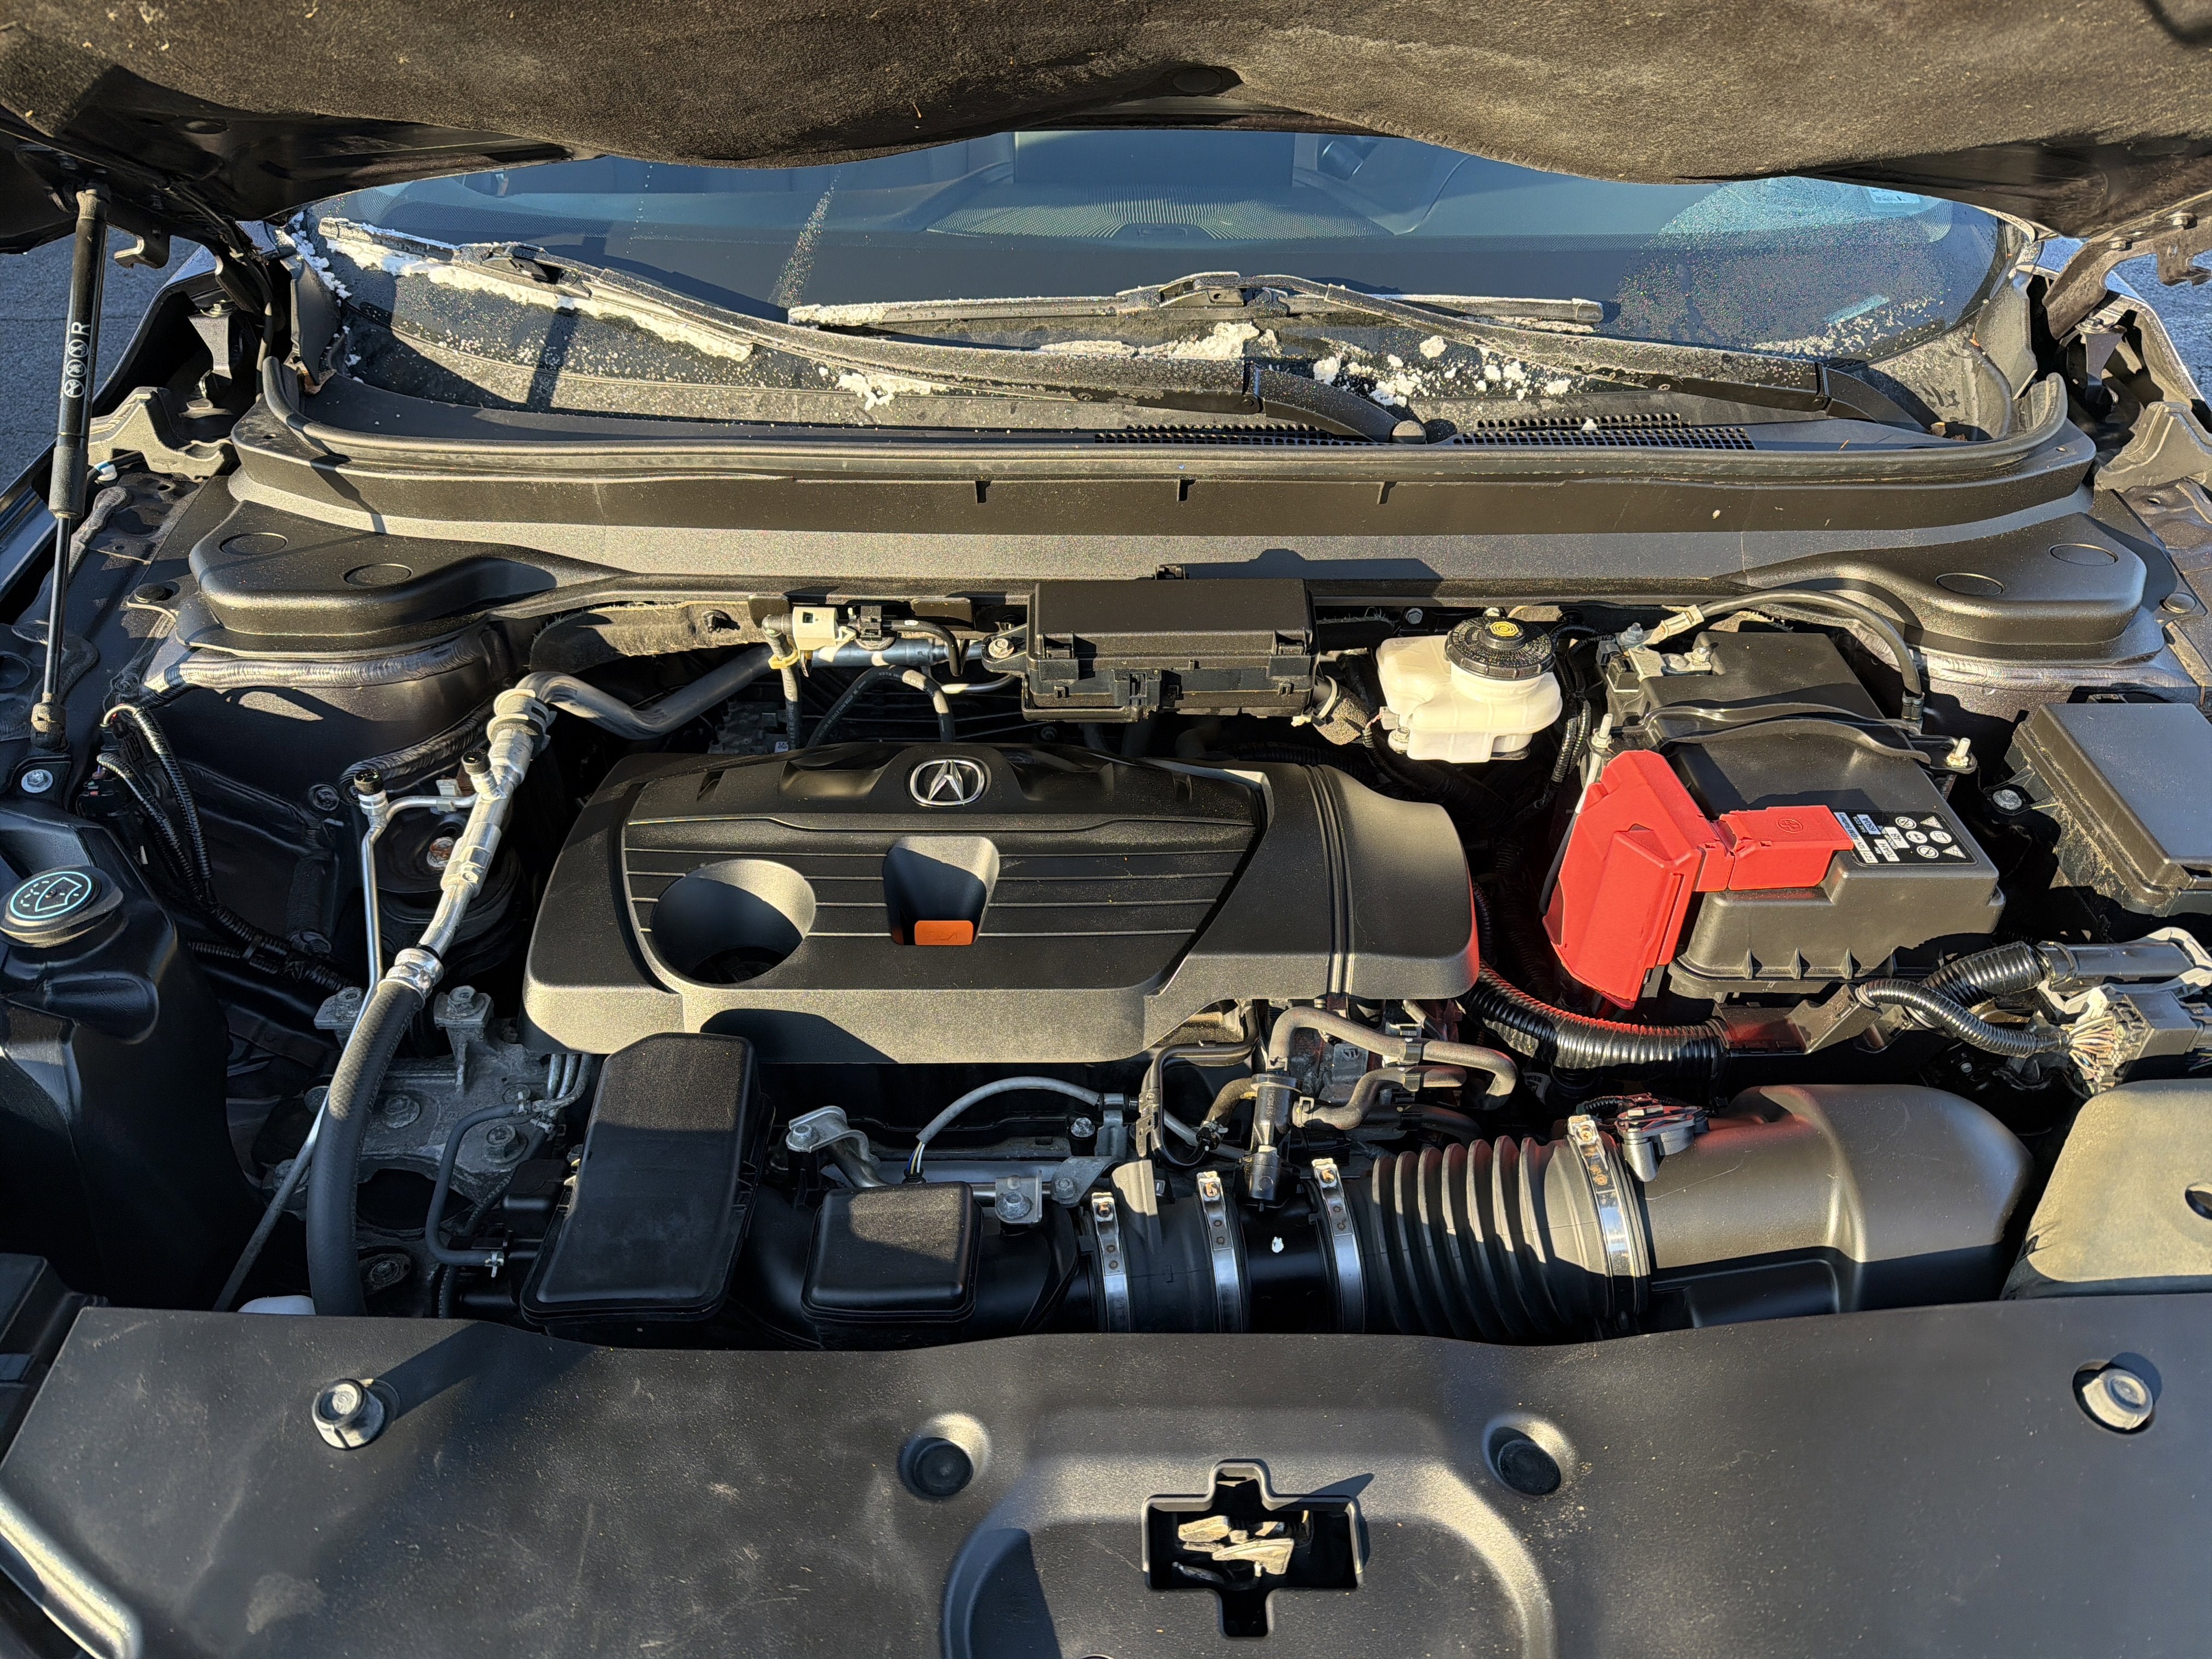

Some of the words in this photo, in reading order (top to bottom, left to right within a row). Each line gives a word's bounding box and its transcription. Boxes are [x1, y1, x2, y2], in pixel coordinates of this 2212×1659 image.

[71, 321, 91, 336] R
[1837, 813, 1852, 828] Battery
[1862, 818, 1877, 831] 650A
[1847, 830, 1859, 840] AGM
[1879, 843, 1895, 858] 70AH
